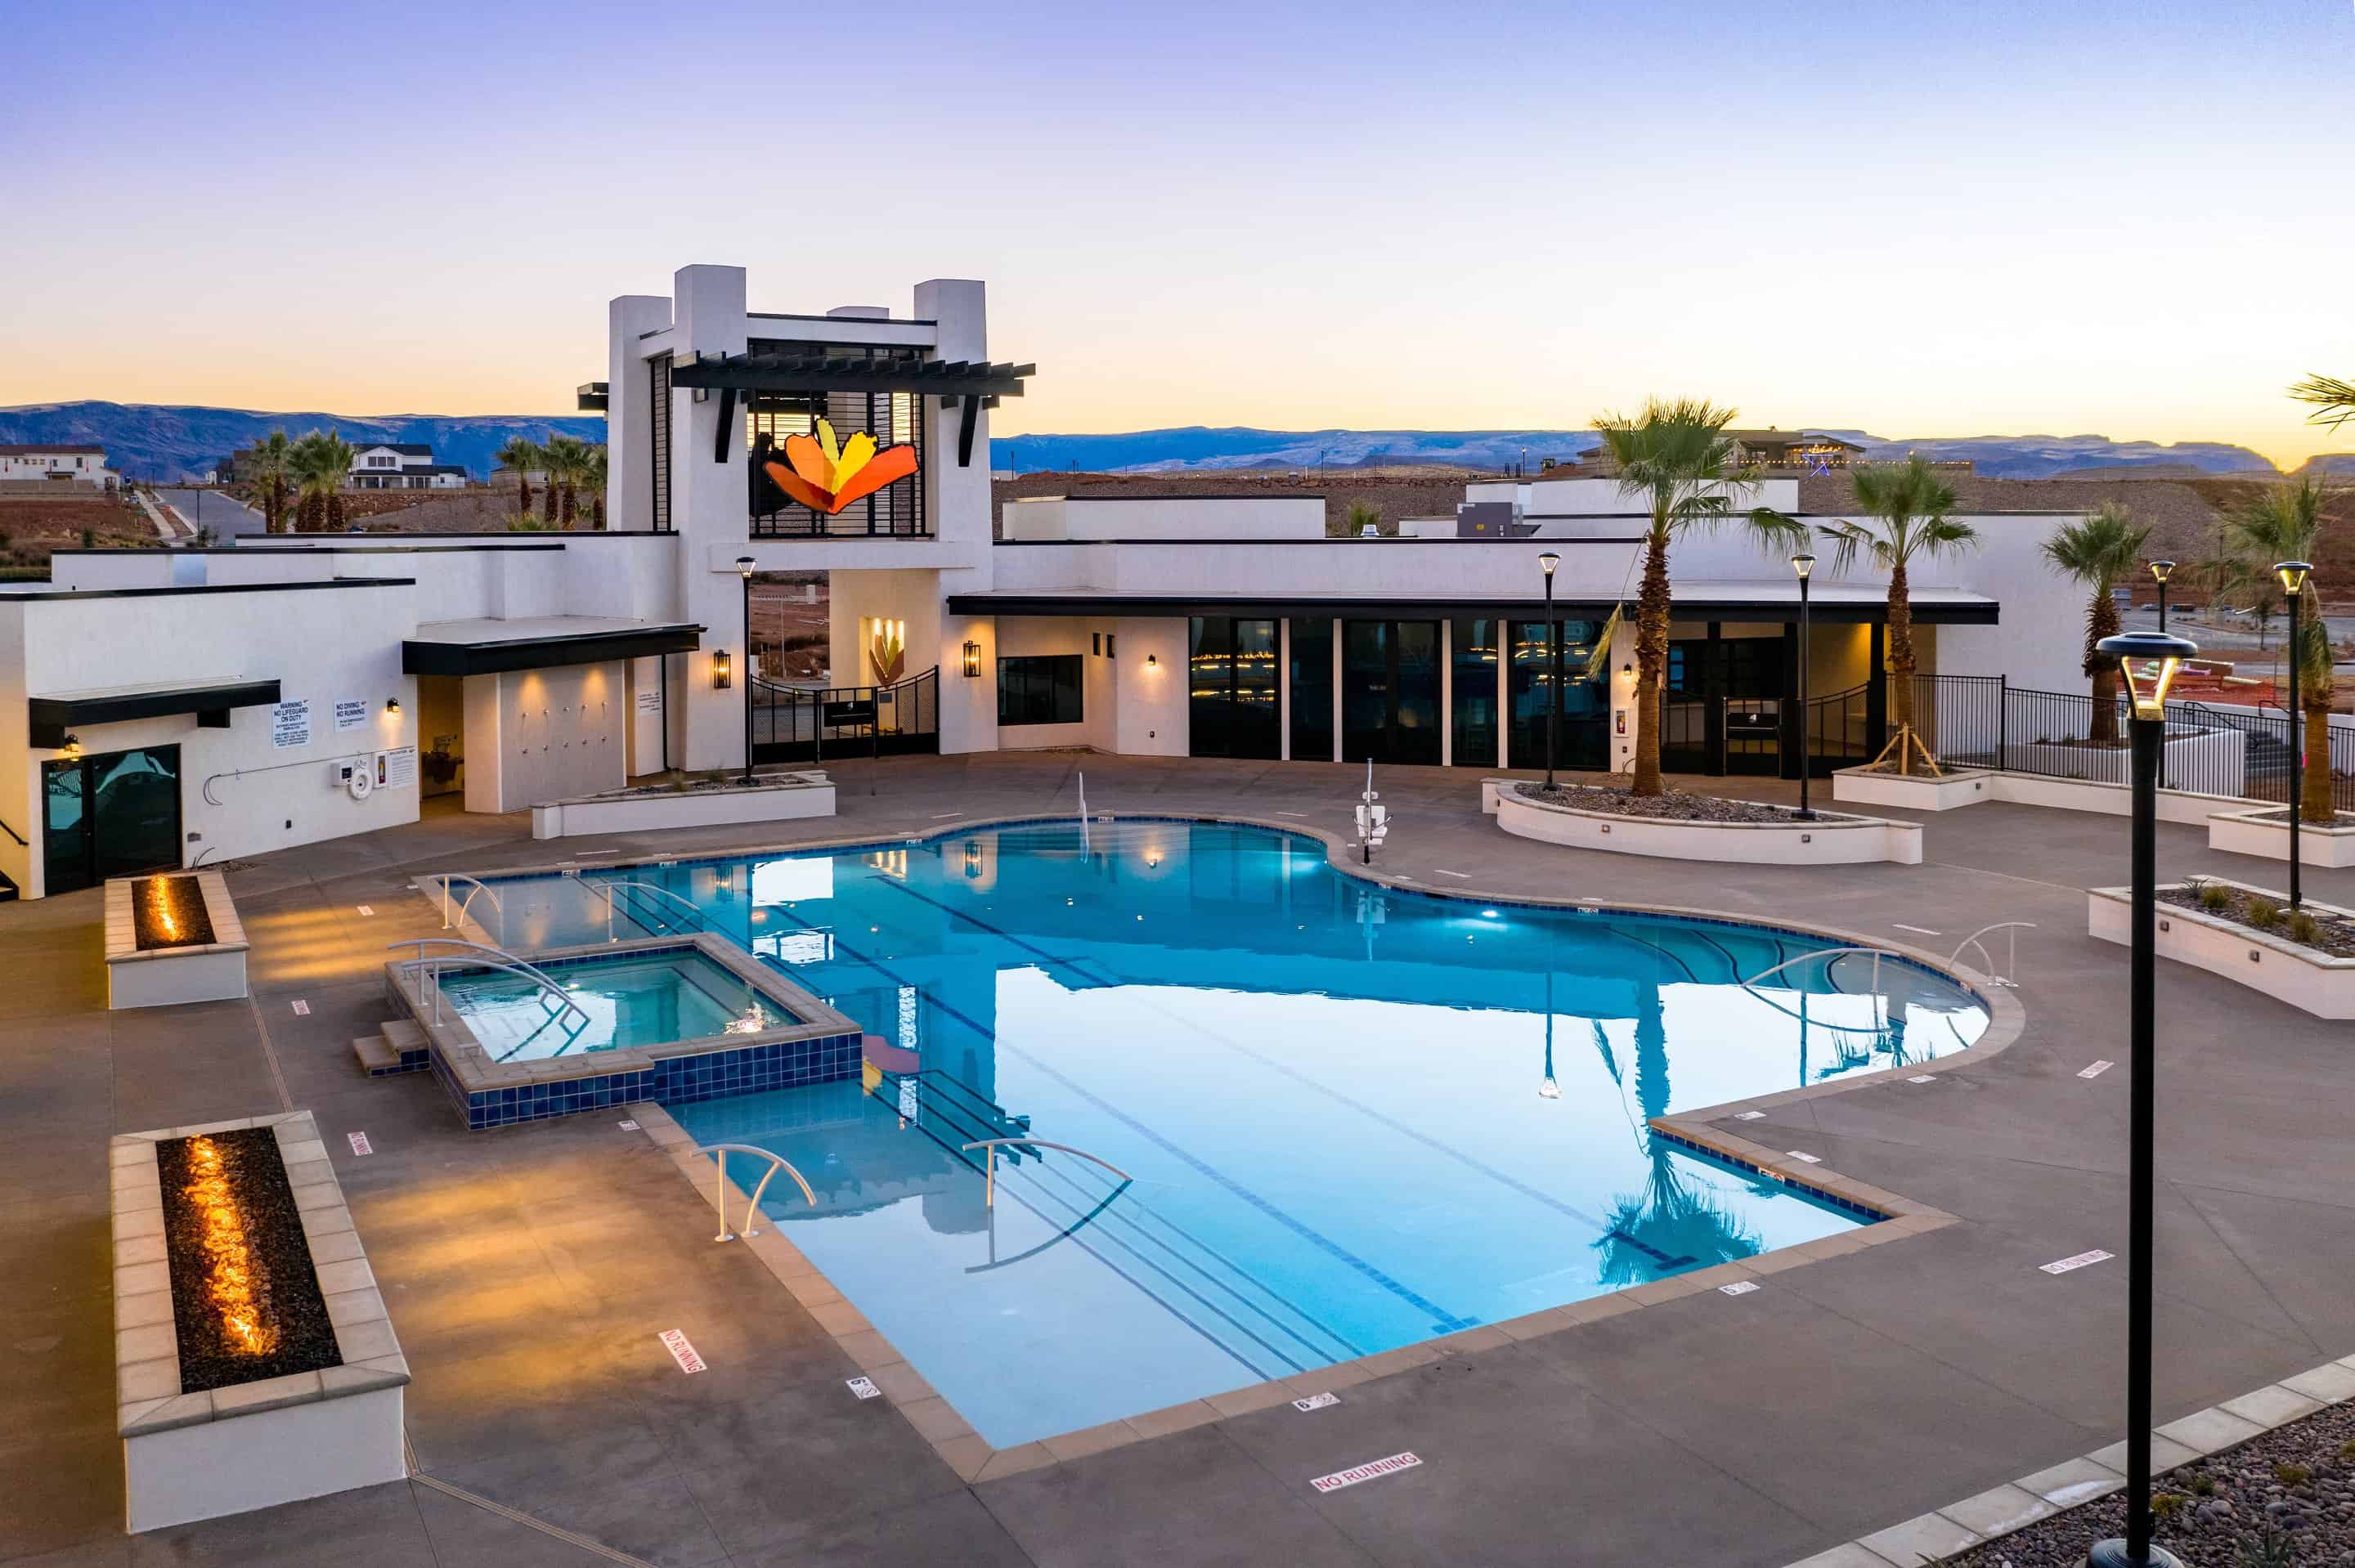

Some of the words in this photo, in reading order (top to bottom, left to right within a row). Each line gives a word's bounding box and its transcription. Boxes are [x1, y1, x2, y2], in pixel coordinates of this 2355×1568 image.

[282, 707, 308, 715] LIFEGUARD
[345, 708, 365, 716] RUNNING
[665, 1331, 681, 1342] NO
[670, 1340, 702, 1371] RUNNING
[1315, 1476, 1342, 1490] NO
[1343, 1454, 1417, 1482] RUNNING
